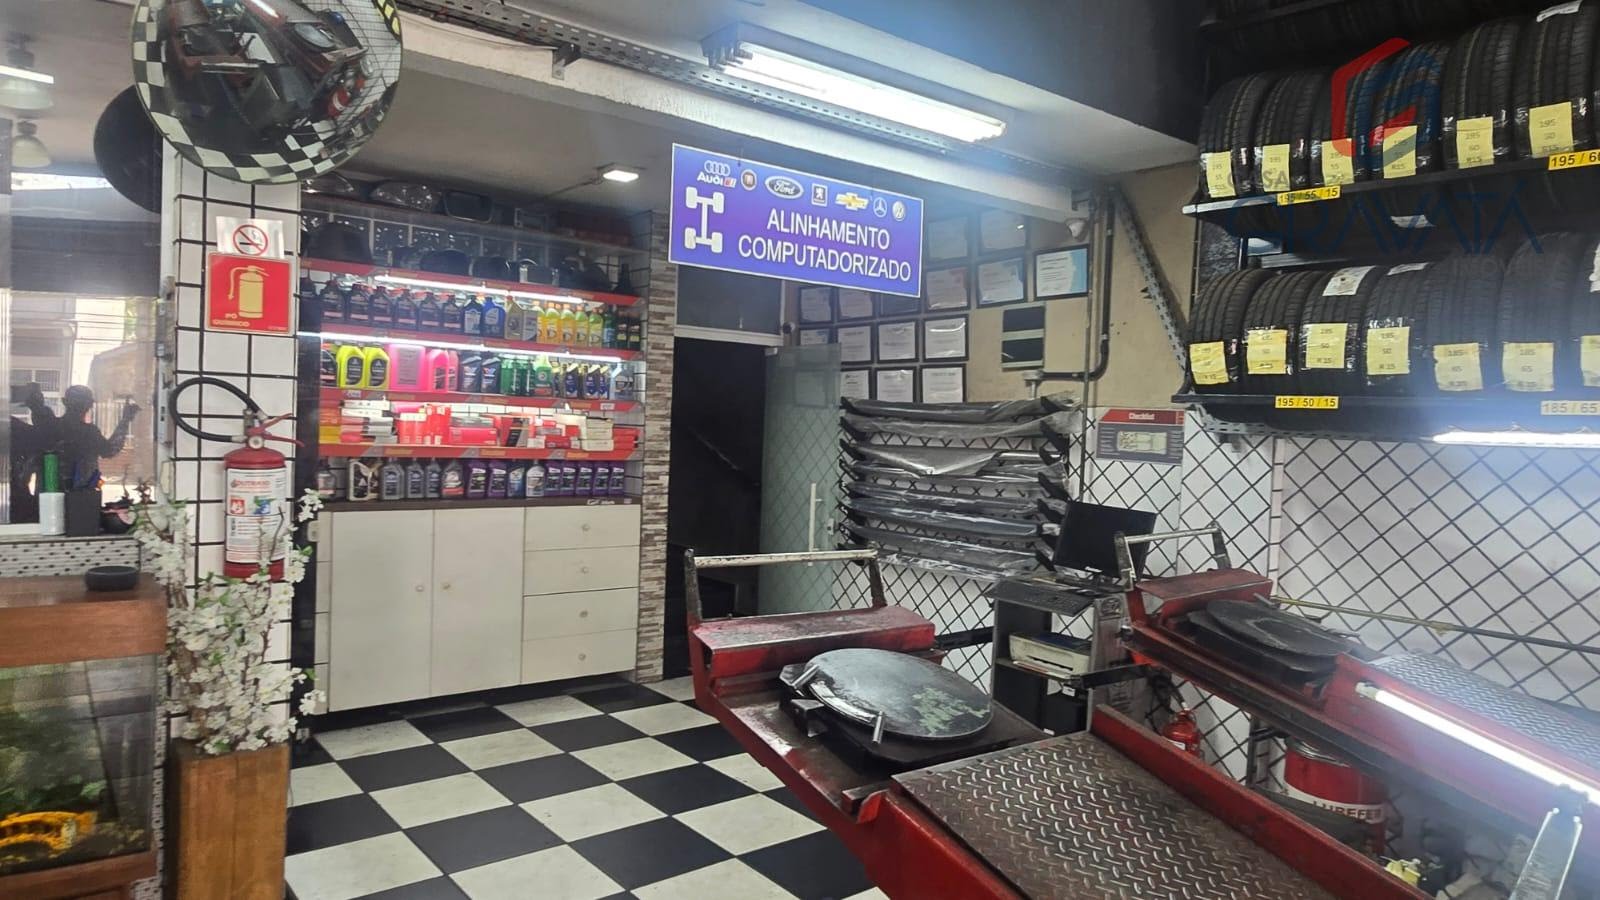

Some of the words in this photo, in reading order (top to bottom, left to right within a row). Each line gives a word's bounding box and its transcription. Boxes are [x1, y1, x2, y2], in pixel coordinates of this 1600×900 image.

[1551, 154, 1575, 167] 195
[773, 180, 796, 195] Ford
[1304, 190, 1317, 200] 55
[1326, 187, 1338, 197] 15
[767, 208, 890, 250] ALINHAMENTO
[738, 235, 911, 282] COMPUTADORIZADO
[1278, 398, 1294, 407] 195
[1303, 398, 1314, 407] 50
[1323, 398, 1336, 407] 15
[1543, 403, 1568, 413] 185
[1580, 403, 1598, 413] 65
